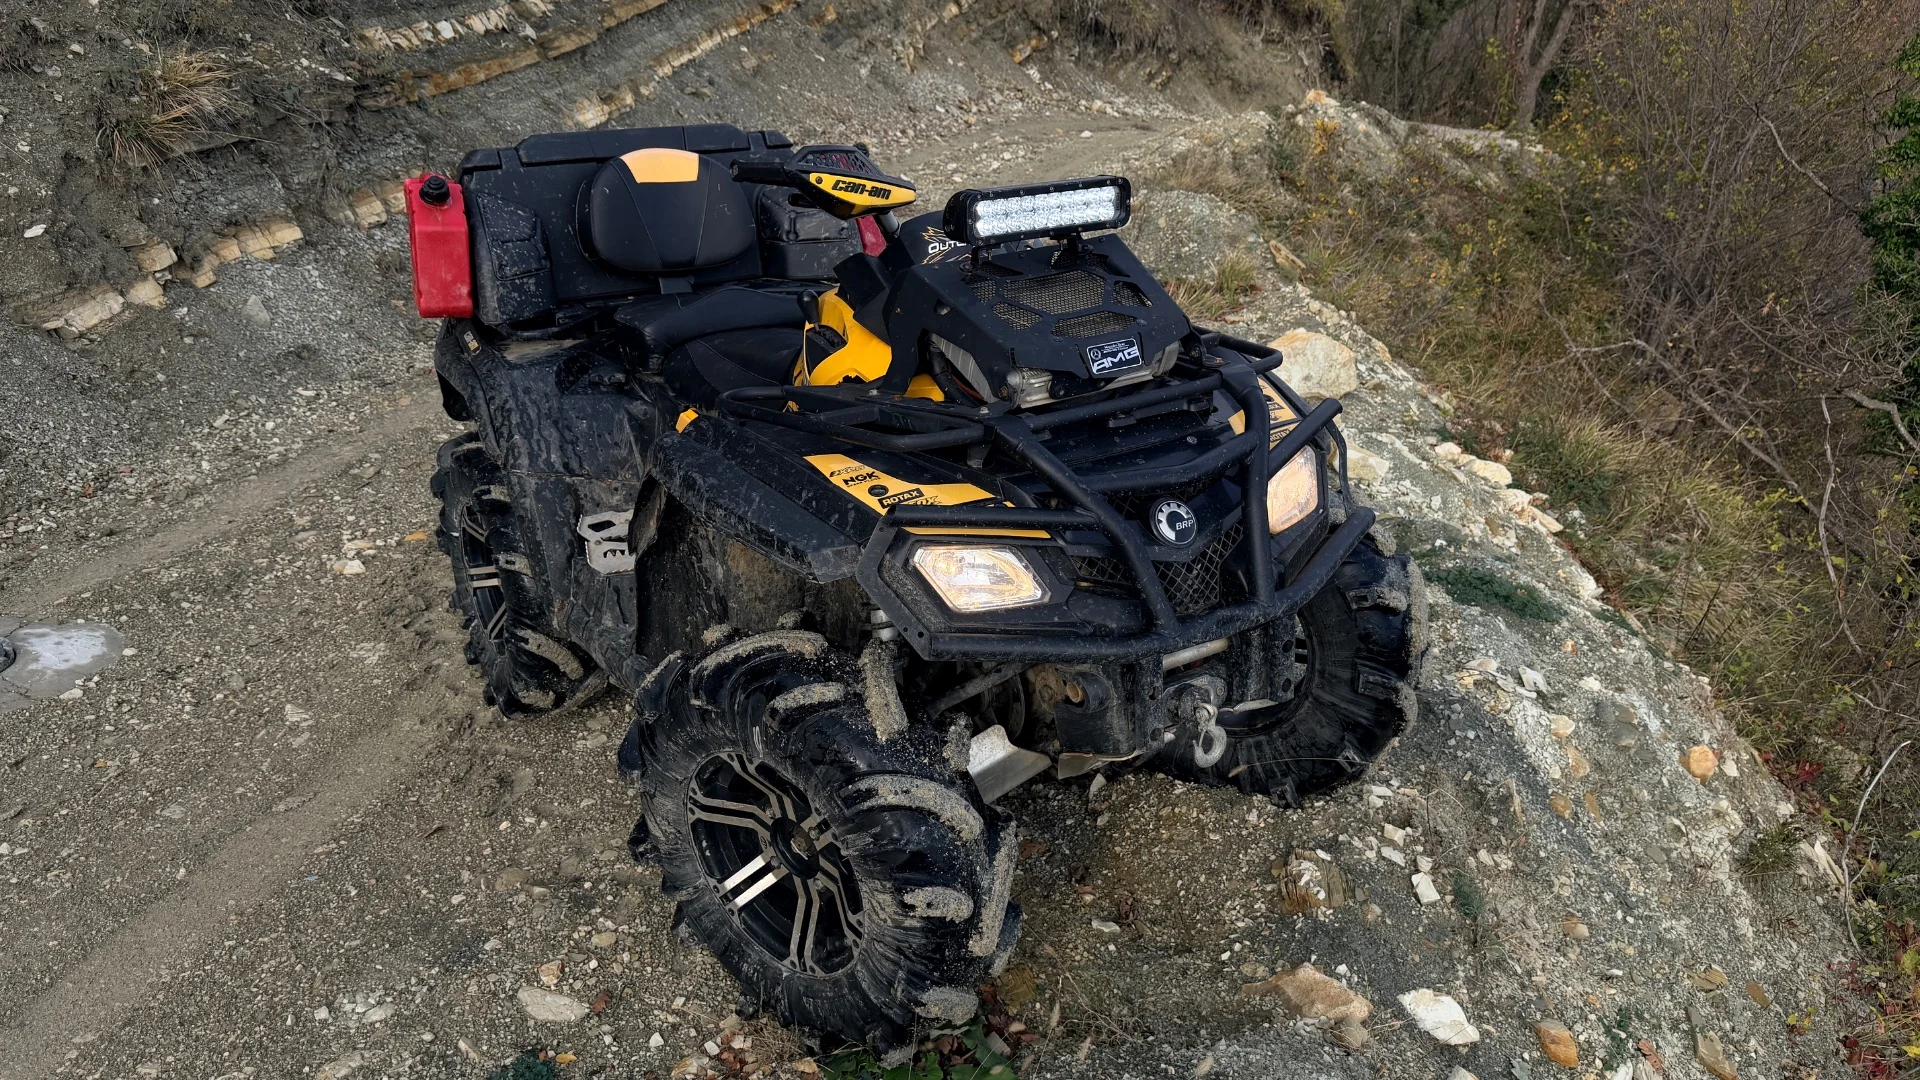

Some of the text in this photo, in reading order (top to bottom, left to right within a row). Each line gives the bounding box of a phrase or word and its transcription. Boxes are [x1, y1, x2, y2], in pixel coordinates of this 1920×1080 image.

[832, 180, 891, 200] can-am
[928, 241, 967, 253] OUTL
[1094, 346, 1139, 372] AMG
[842, 471, 879, 485] NGK
[882, 491, 919, 506] ROTAX
[1176, 520, 1194, 530] BRP
